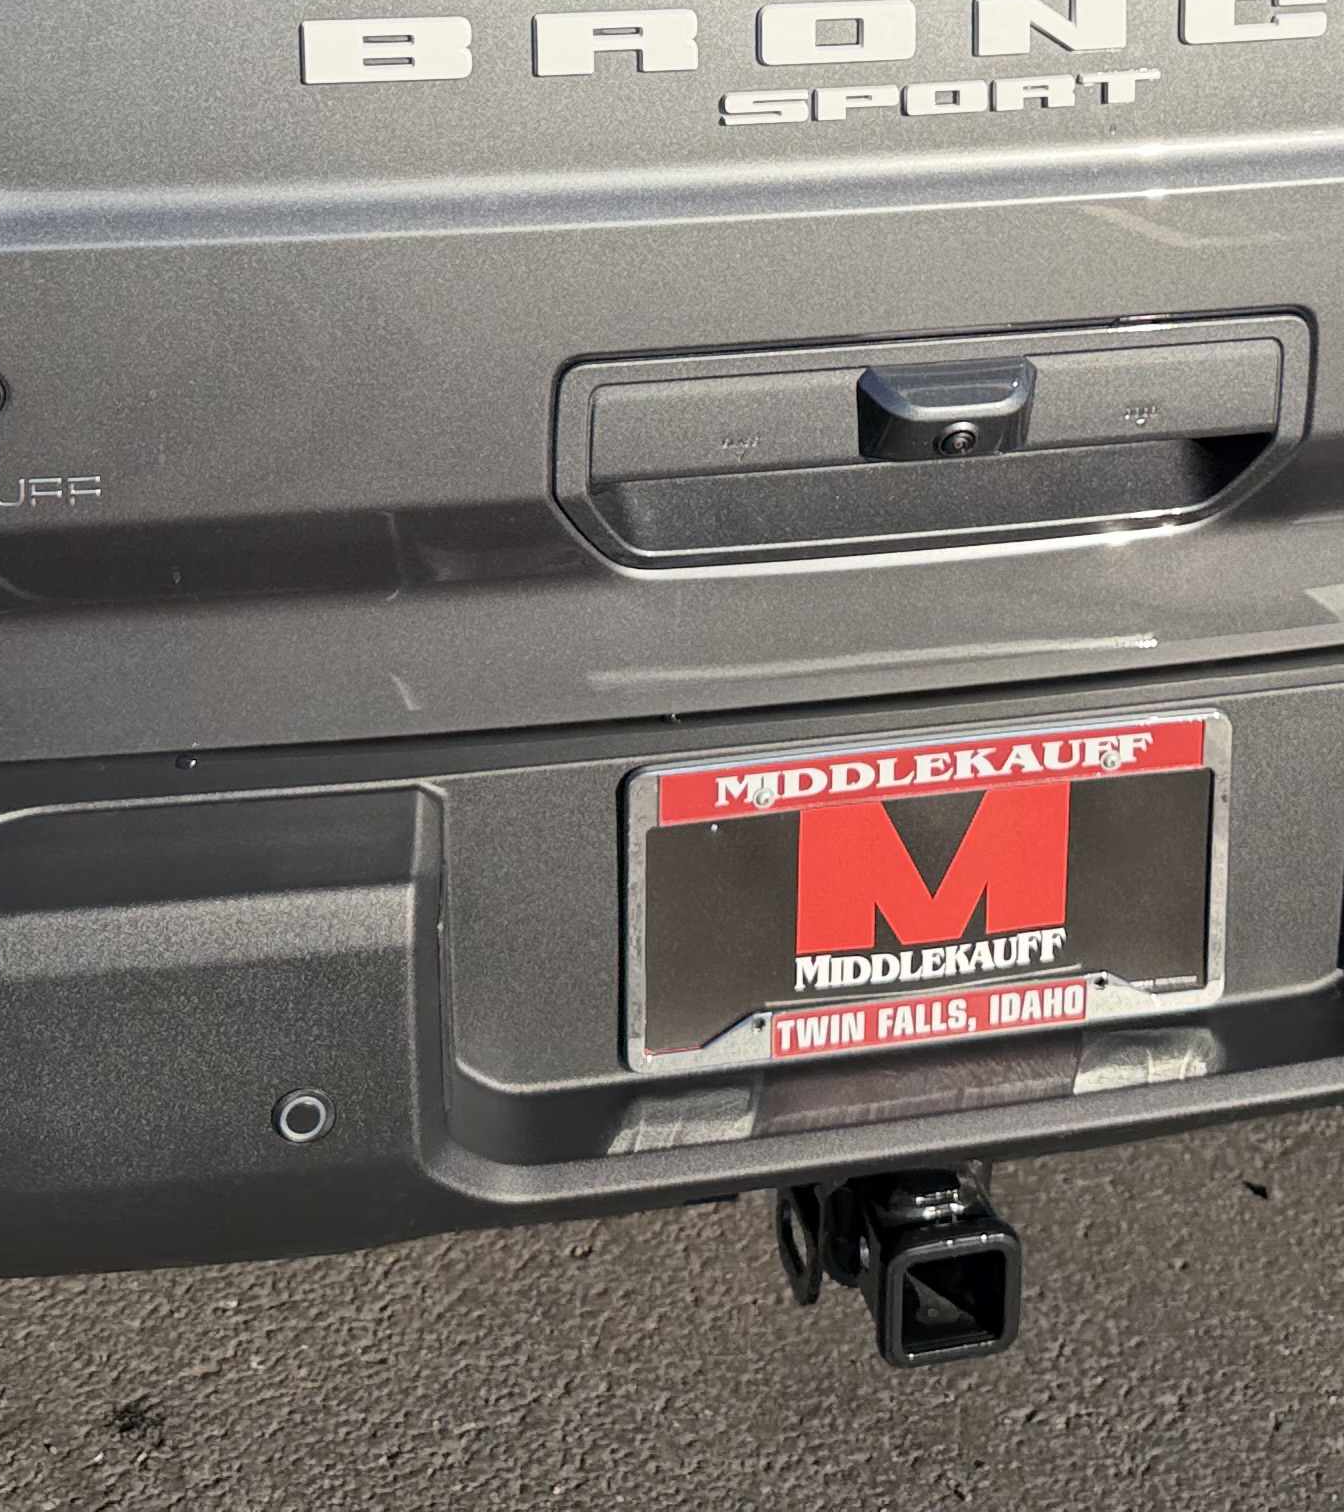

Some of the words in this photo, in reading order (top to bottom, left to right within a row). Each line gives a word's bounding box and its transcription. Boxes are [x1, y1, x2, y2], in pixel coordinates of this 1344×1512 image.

[719, 67, 1161, 126] SPORT
[714, 732, 1154, 807] MIDDLEKAUFF
[796, 782, 1071, 955] M
[794, 927, 1067, 992] MIDDLEKAUFF
[776, 1010, 866, 1051] TWIN
[877, 998, 978, 1040] FALLS,
[989, 984, 1084, 1026] IDAHO
